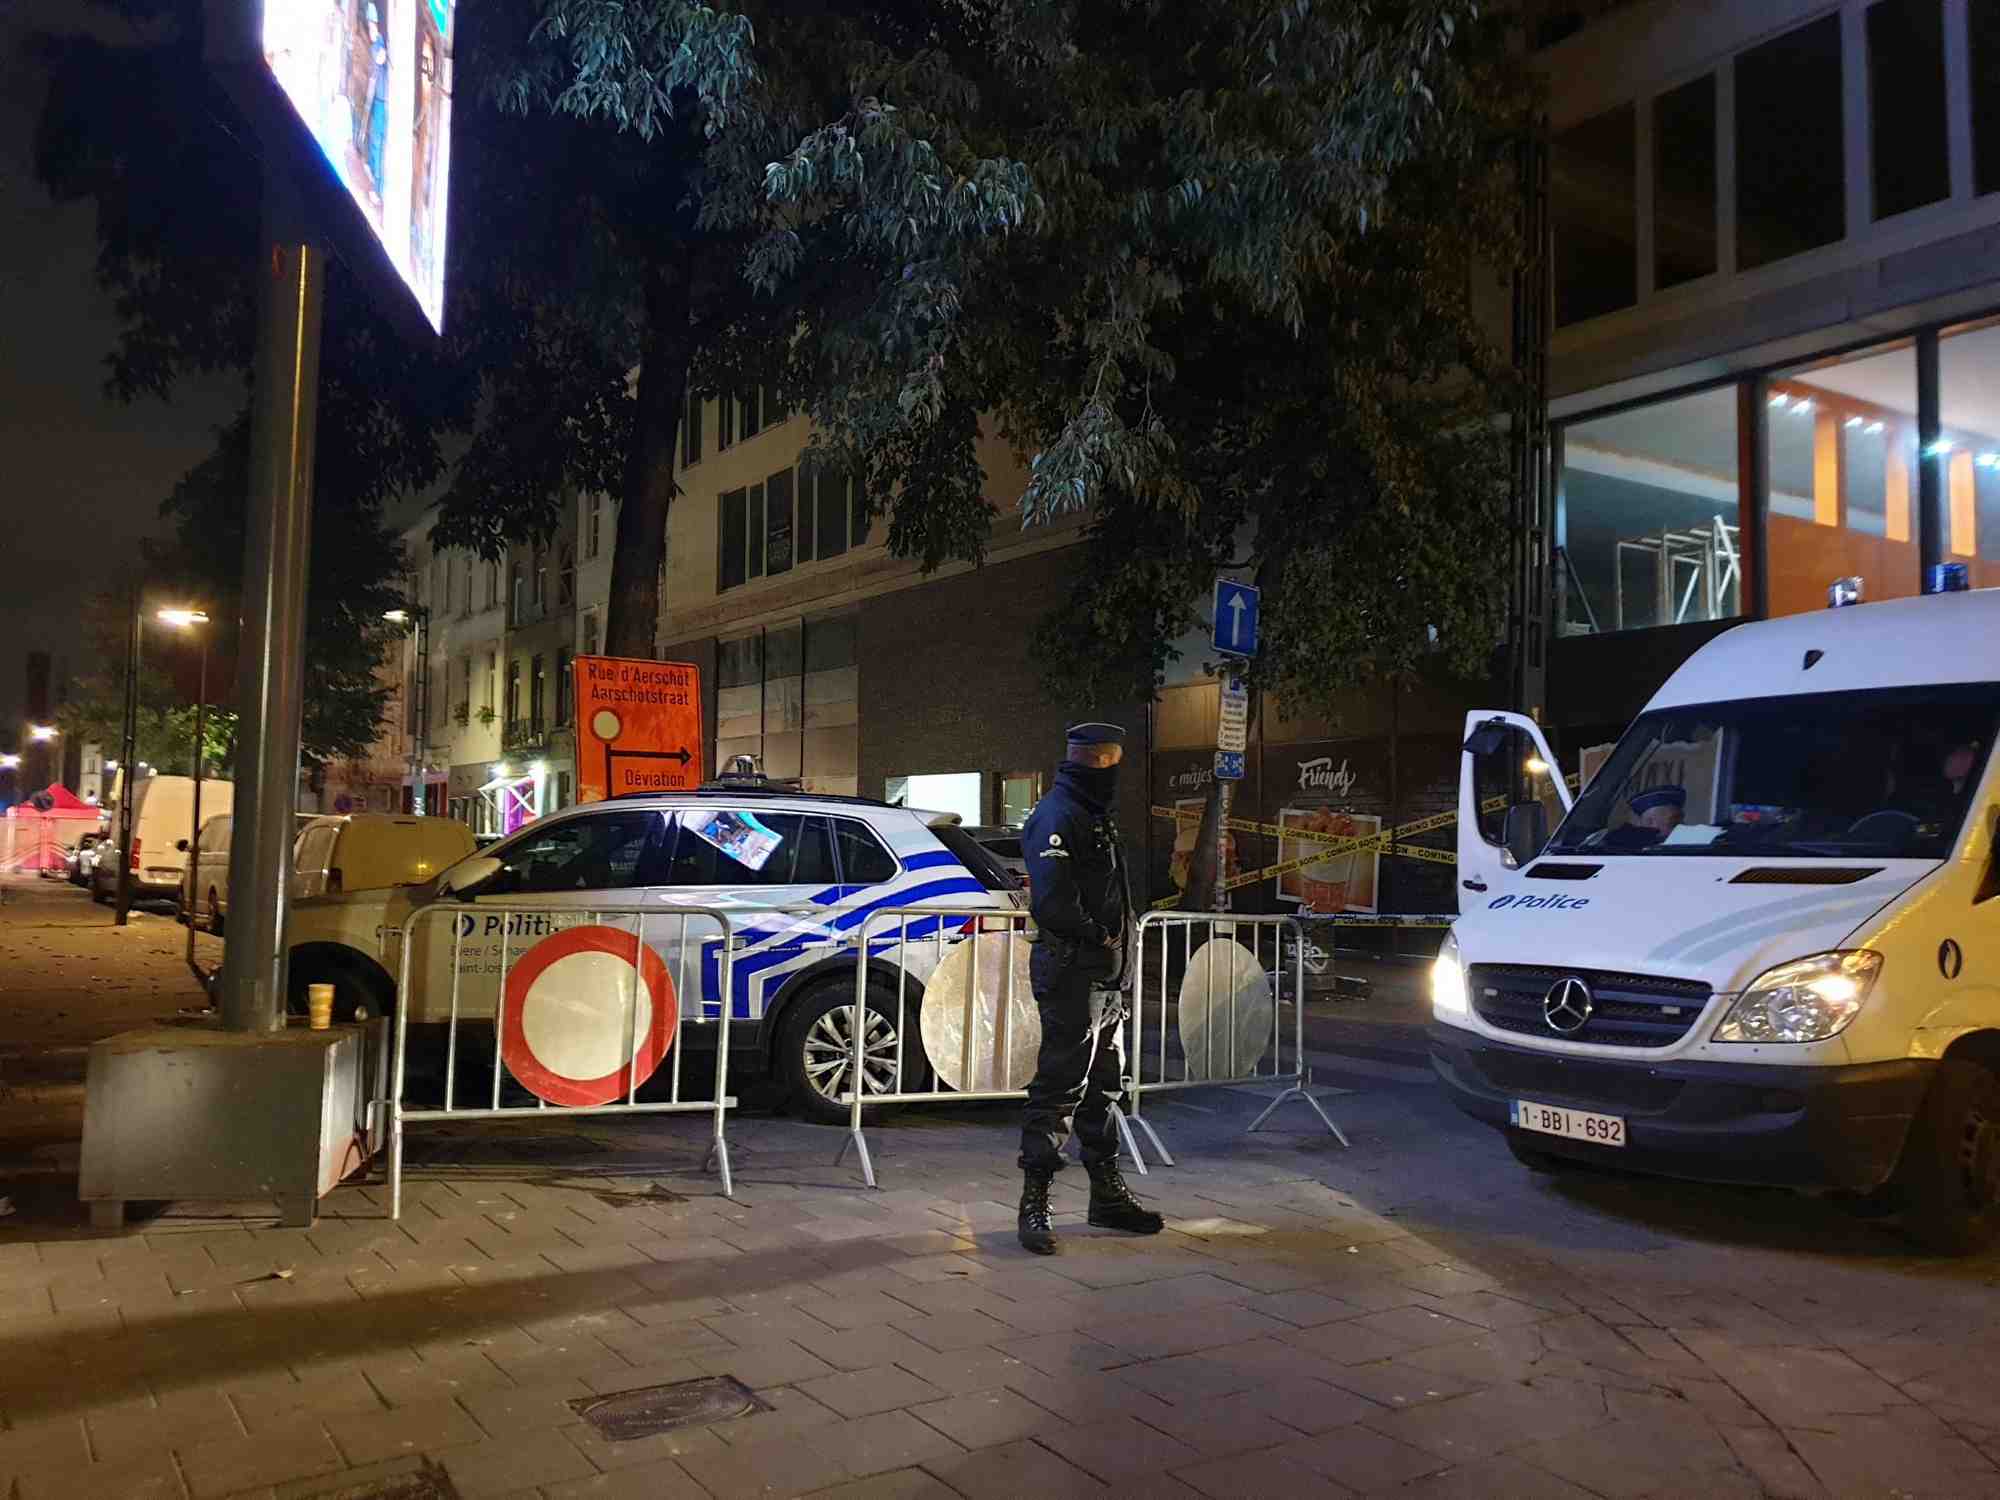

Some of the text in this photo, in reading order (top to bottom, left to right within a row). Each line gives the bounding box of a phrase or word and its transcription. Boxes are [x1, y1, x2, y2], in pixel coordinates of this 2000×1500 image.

[588, 663, 690, 687] Rue d'Aerschot
[591, 683, 689, 706] Aarschotstraat
[625, 768, 686, 787] Déviation
[1418, 849, 1455, 862] COMING
[1511, 894, 1590, 909] Police
[484, 914, 560, 936] Politi
[1522, 1105, 1622, 1142] 1-BBI-692
